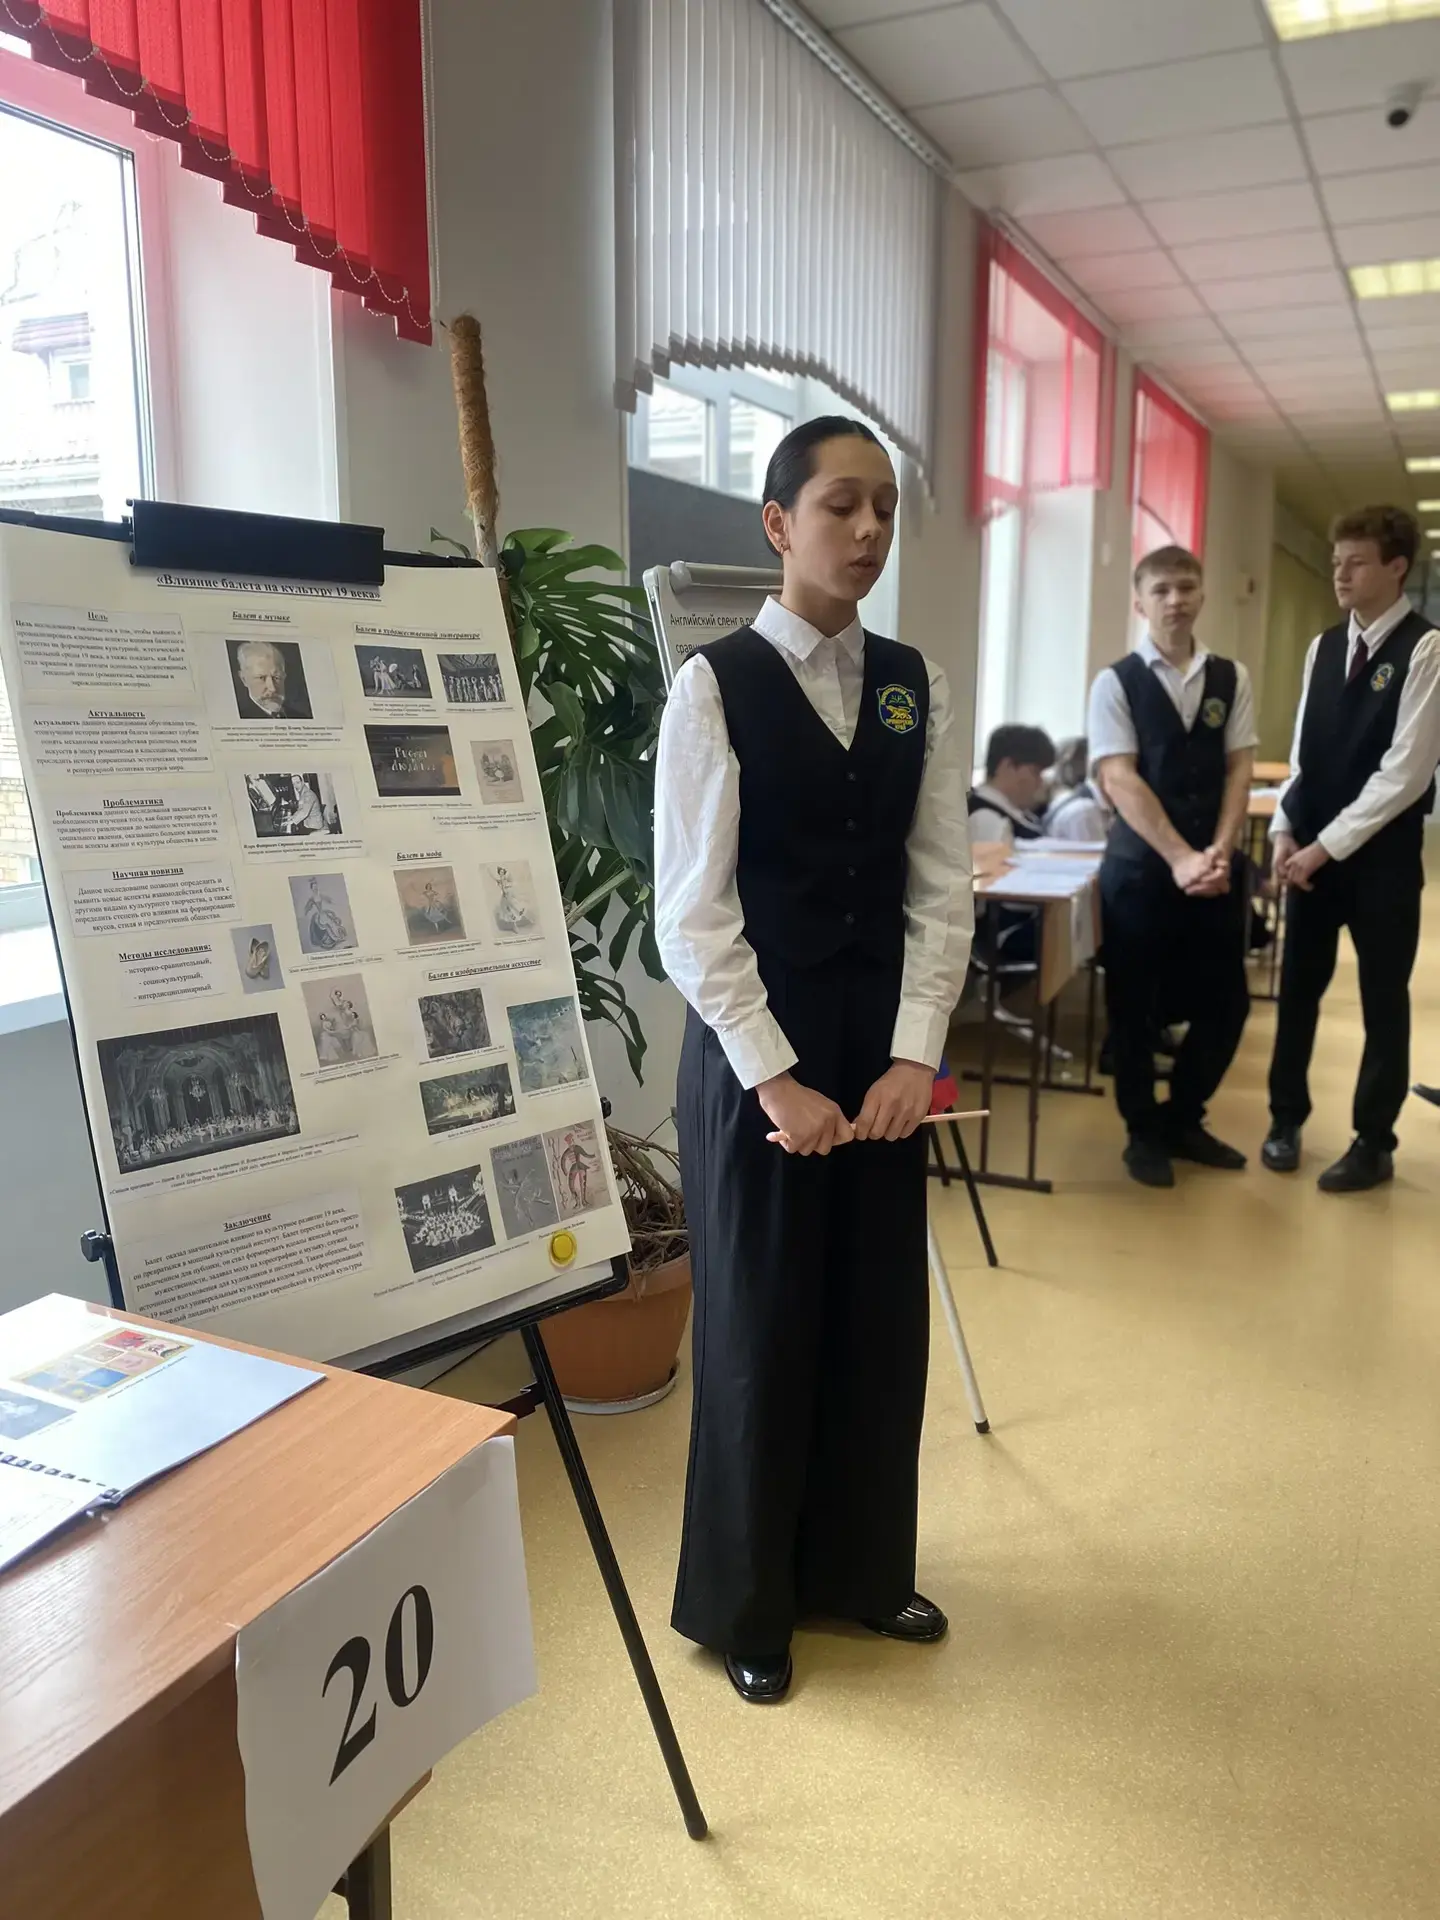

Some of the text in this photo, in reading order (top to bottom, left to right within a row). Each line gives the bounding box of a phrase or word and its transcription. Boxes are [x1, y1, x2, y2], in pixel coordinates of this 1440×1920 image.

[156, 574, 380, 599] «Влияние балета на культуру 19 века»
[88, 611, 108, 620] Цель
[232, 611, 256, 620] Балет
[670, 613, 716, 626] Английский
[717, 617, 738, 626] сленг
[739, 617, 744, 625] в
[87, 709, 146, 719] Актуальность
[32, 718, 80, 727] Актуальность
[102, 797, 164, 808] Проблематика
[56, 809, 102, 818] Проблематика
[396, 852, 418, 860] Балет
[425, 849, 442, 858] мода
[112, 868, 184, 879] Научная новизна
[118, 944, 212, 960] Методы исследования:
[427, 972, 449, 980] Балет
[223, 1214, 271, 1230] Заключение
[321, 1584, 435, 1787] 20
